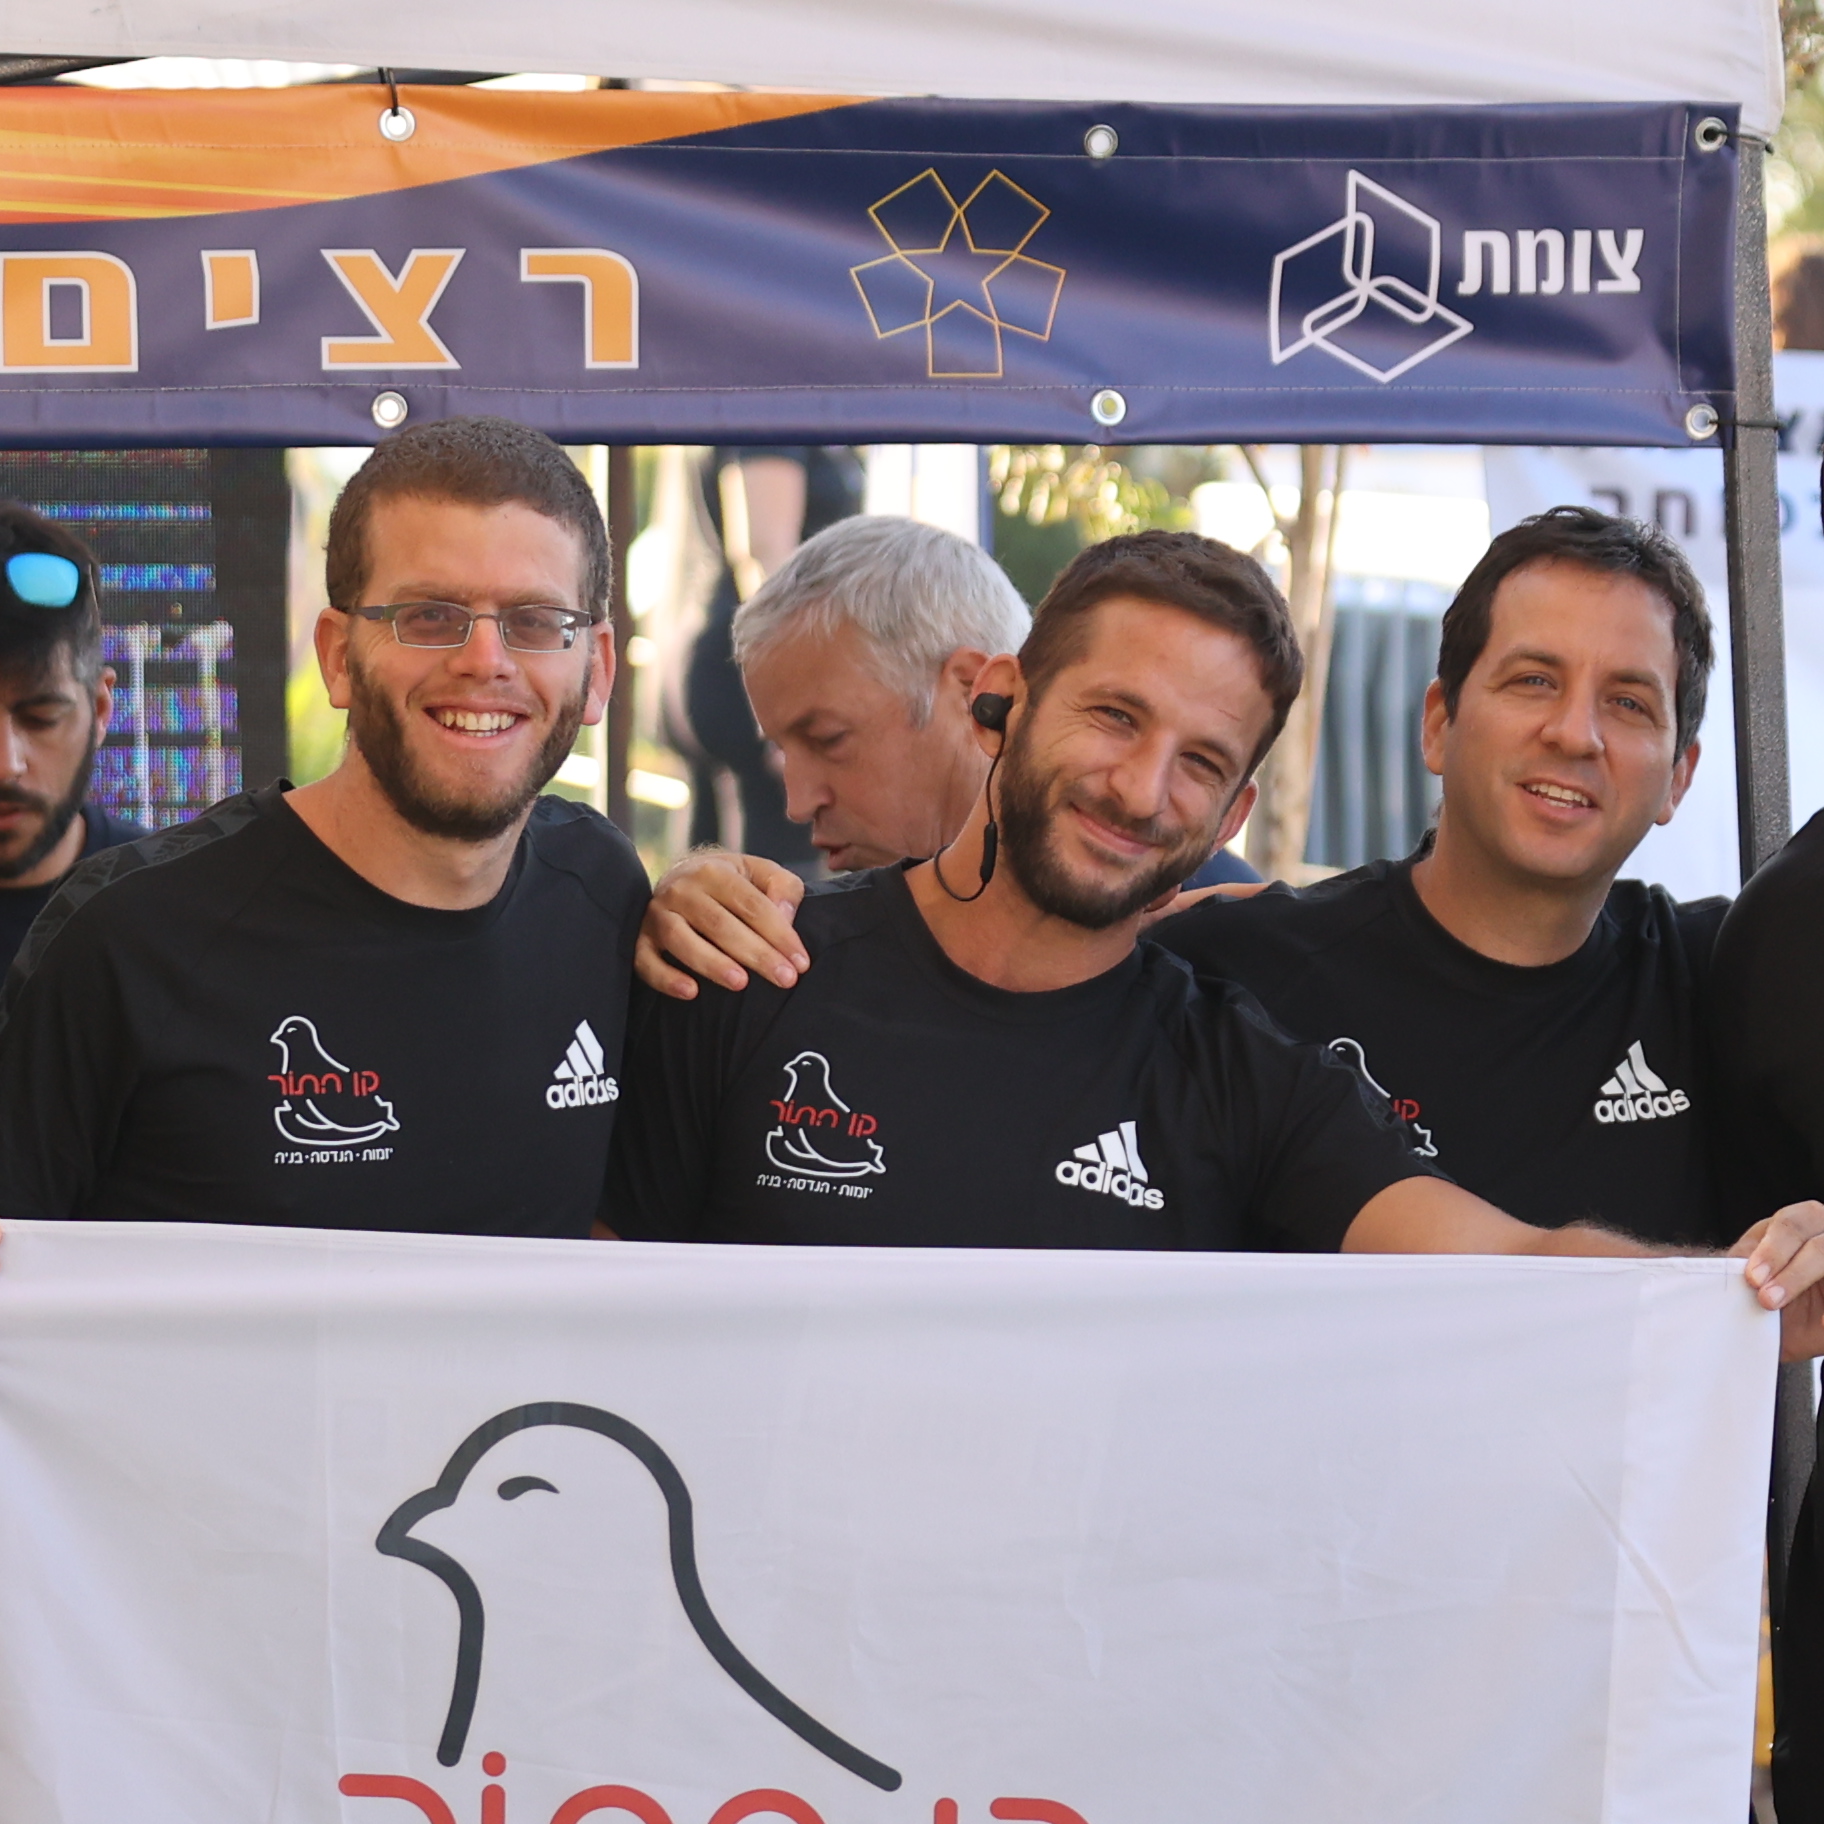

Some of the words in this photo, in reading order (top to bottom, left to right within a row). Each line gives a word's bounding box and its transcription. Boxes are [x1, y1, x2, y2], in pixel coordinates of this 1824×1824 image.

[1458, 227, 1645, 295] צומת
[545, 1073, 621, 1110] adidas
[1593, 1087, 1692, 1125] adidas
[1054, 1160, 1166, 1211] adidas
